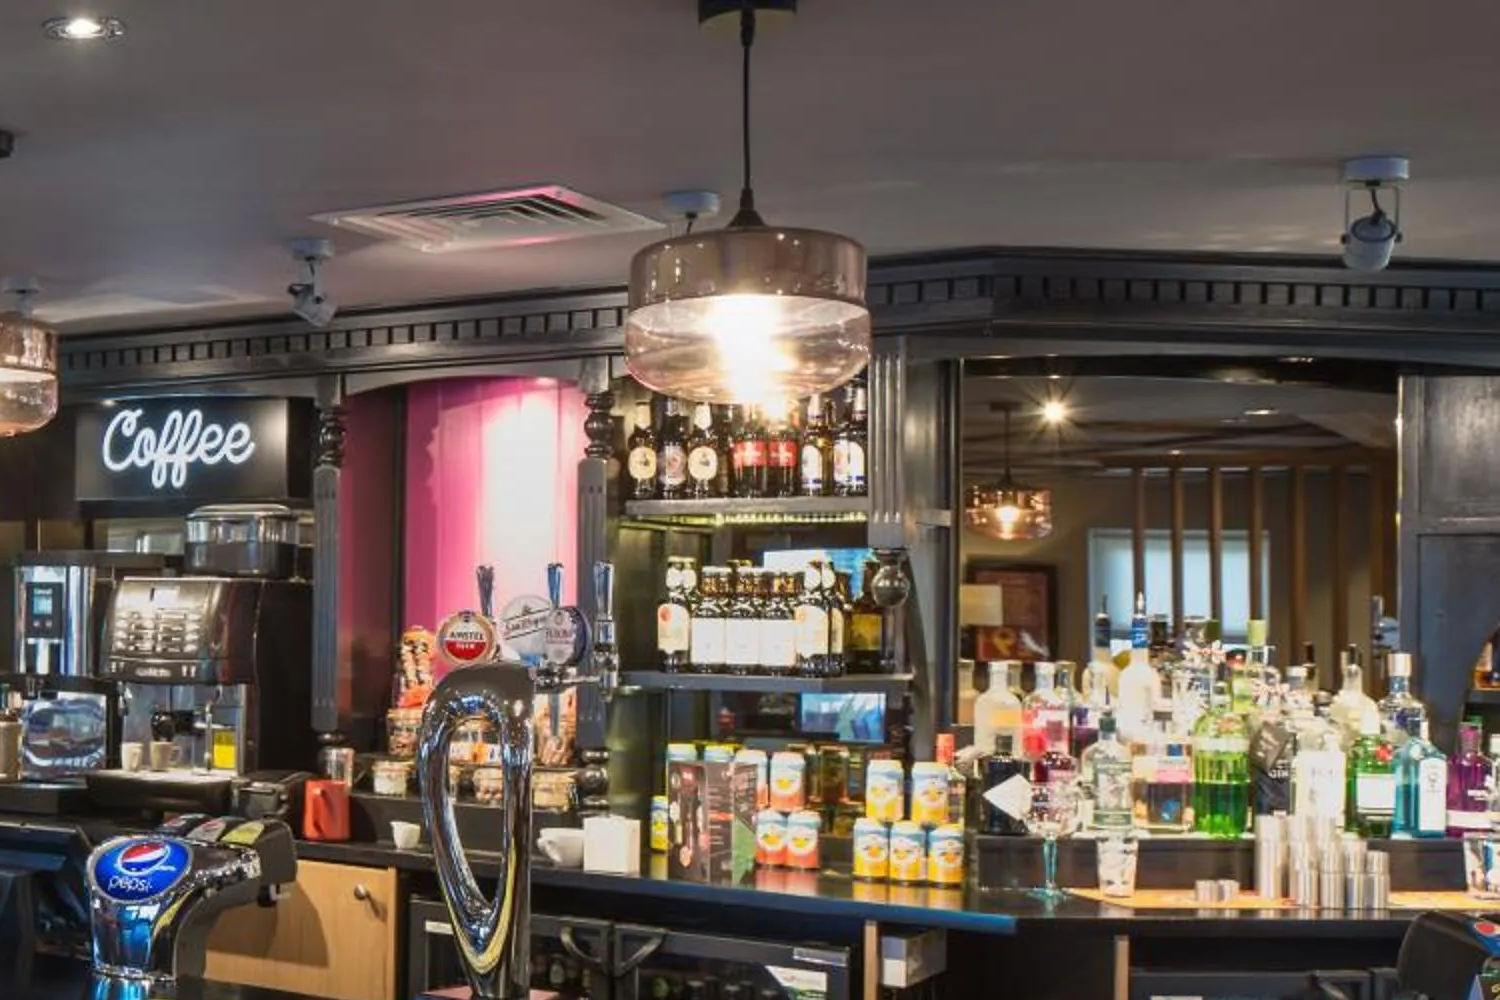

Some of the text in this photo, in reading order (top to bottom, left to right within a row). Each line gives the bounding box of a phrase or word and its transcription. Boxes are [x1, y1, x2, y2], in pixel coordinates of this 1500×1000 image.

[102, 408, 256, 488] Coffee
[450, 630, 484, 641] AMSTEL
[108, 874, 153, 893] pepsi
